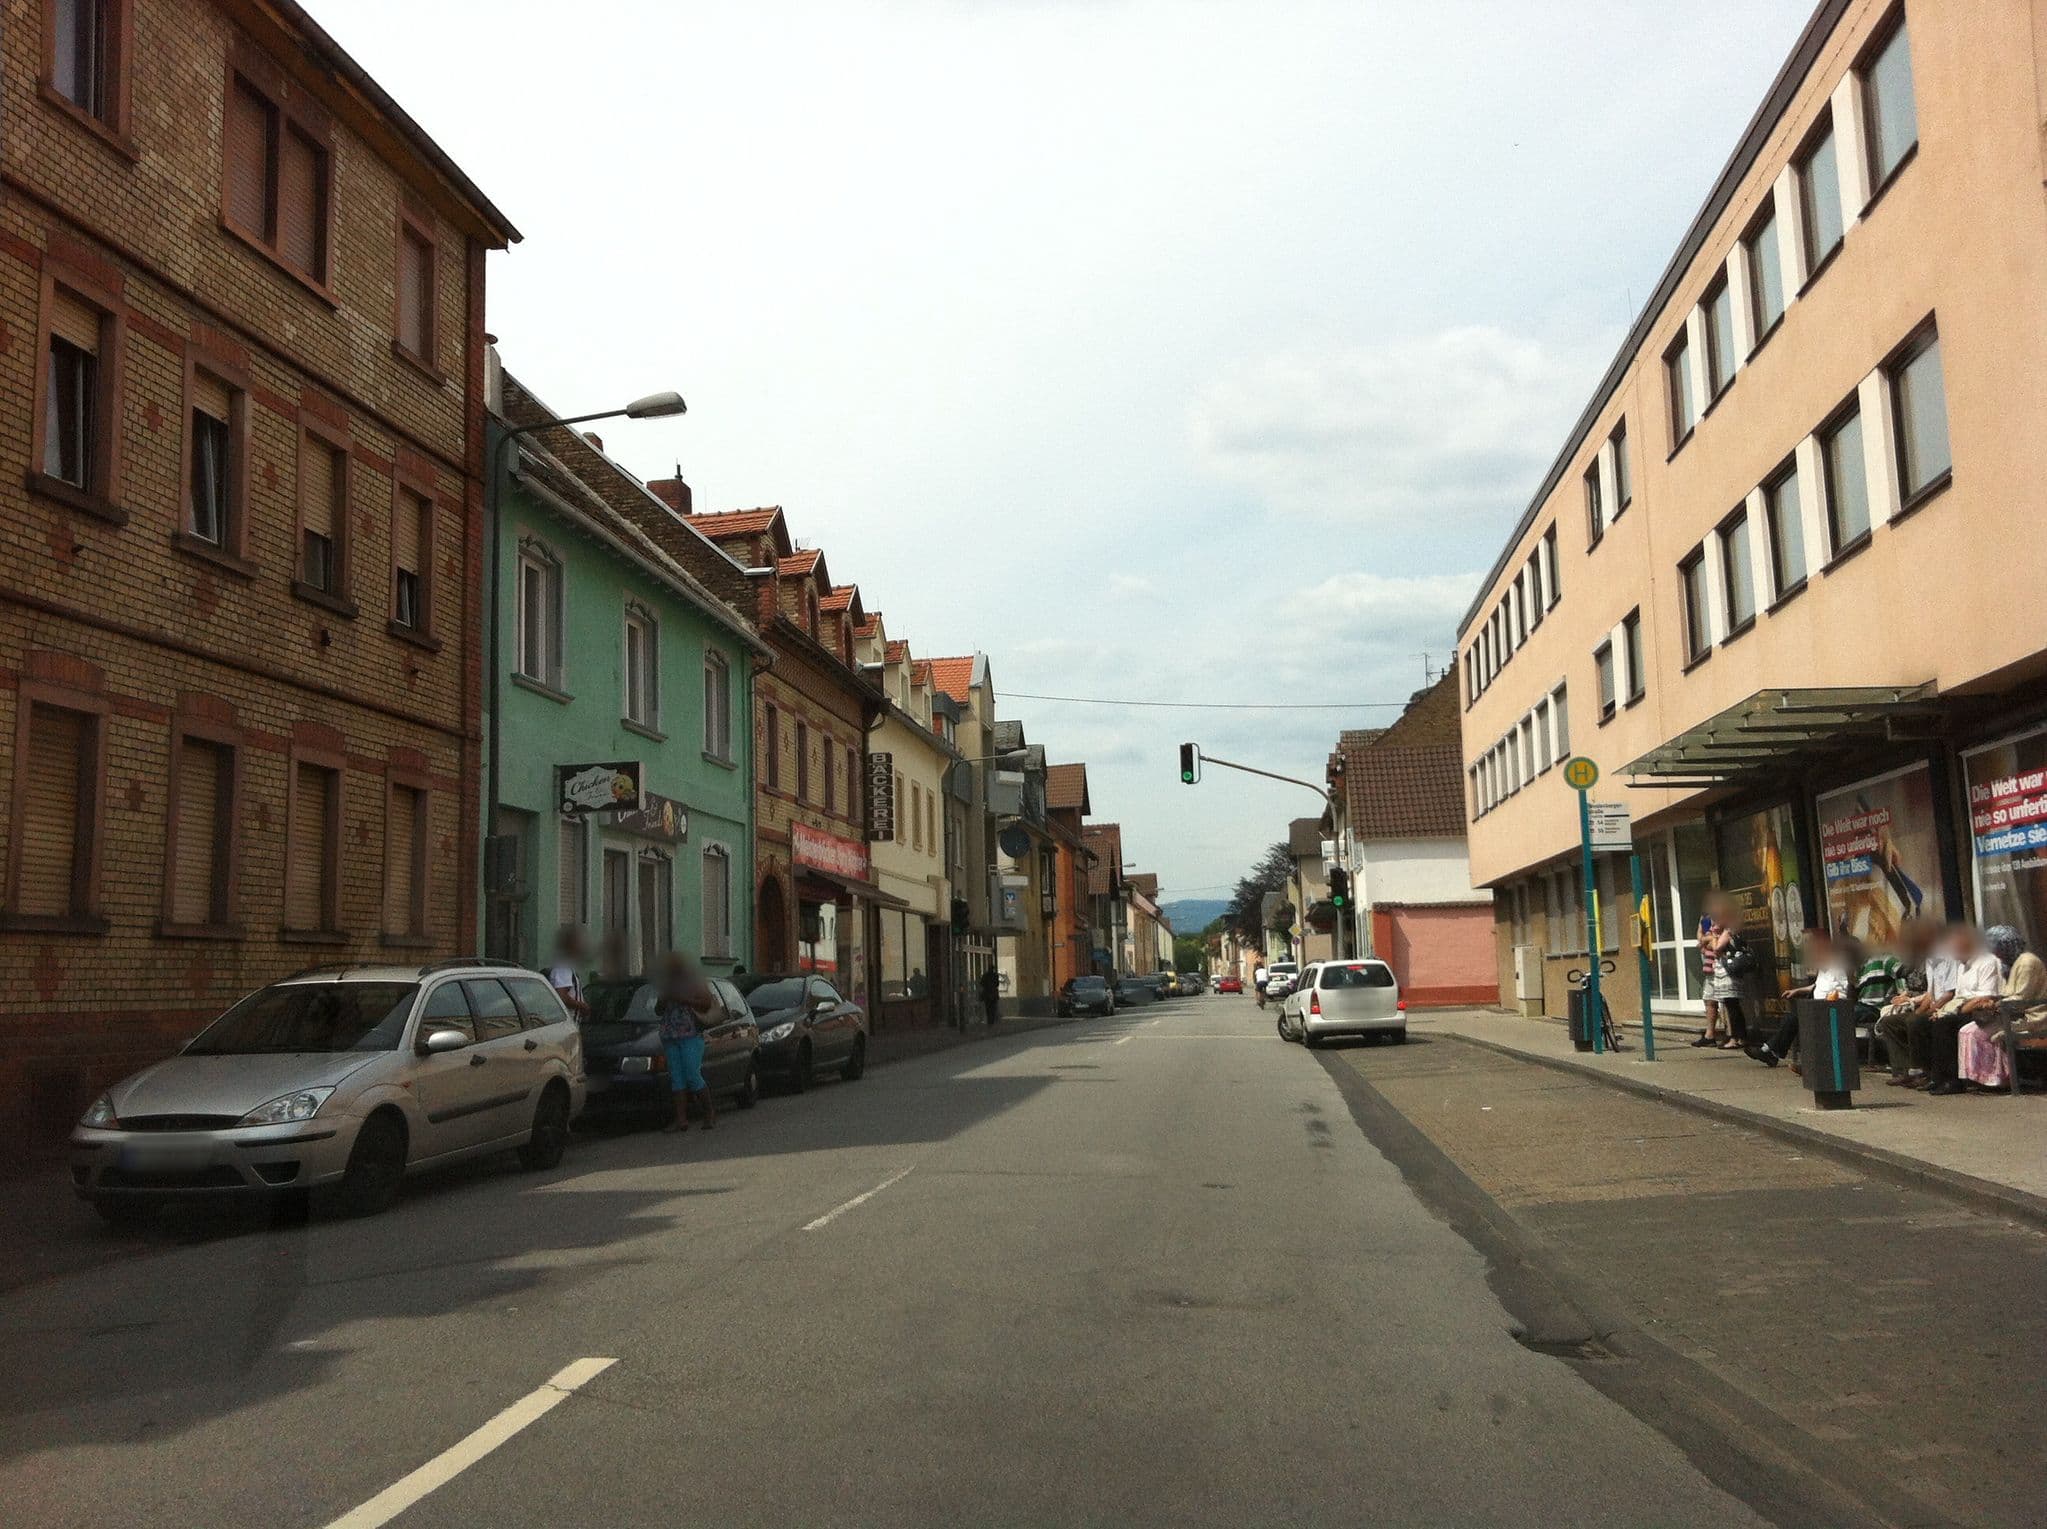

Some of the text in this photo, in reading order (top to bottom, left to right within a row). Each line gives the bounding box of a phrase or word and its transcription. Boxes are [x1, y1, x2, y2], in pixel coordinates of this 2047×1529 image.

[1574, 764, 1588, 782] H
[1972, 771, 2044, 803] Die Welt war
[1822, 808, 1890, 838] Die Welt war noch
[1974, 809, 1991, 828] nie
[1993, 809, 2007, 824] so
[1824, 845, 1836, 858] nie
[1837, 843, 1847, 856] so
[1977, 829, 2027, 853] Vernetze
[1826, 863, 1839, 878] Gib
